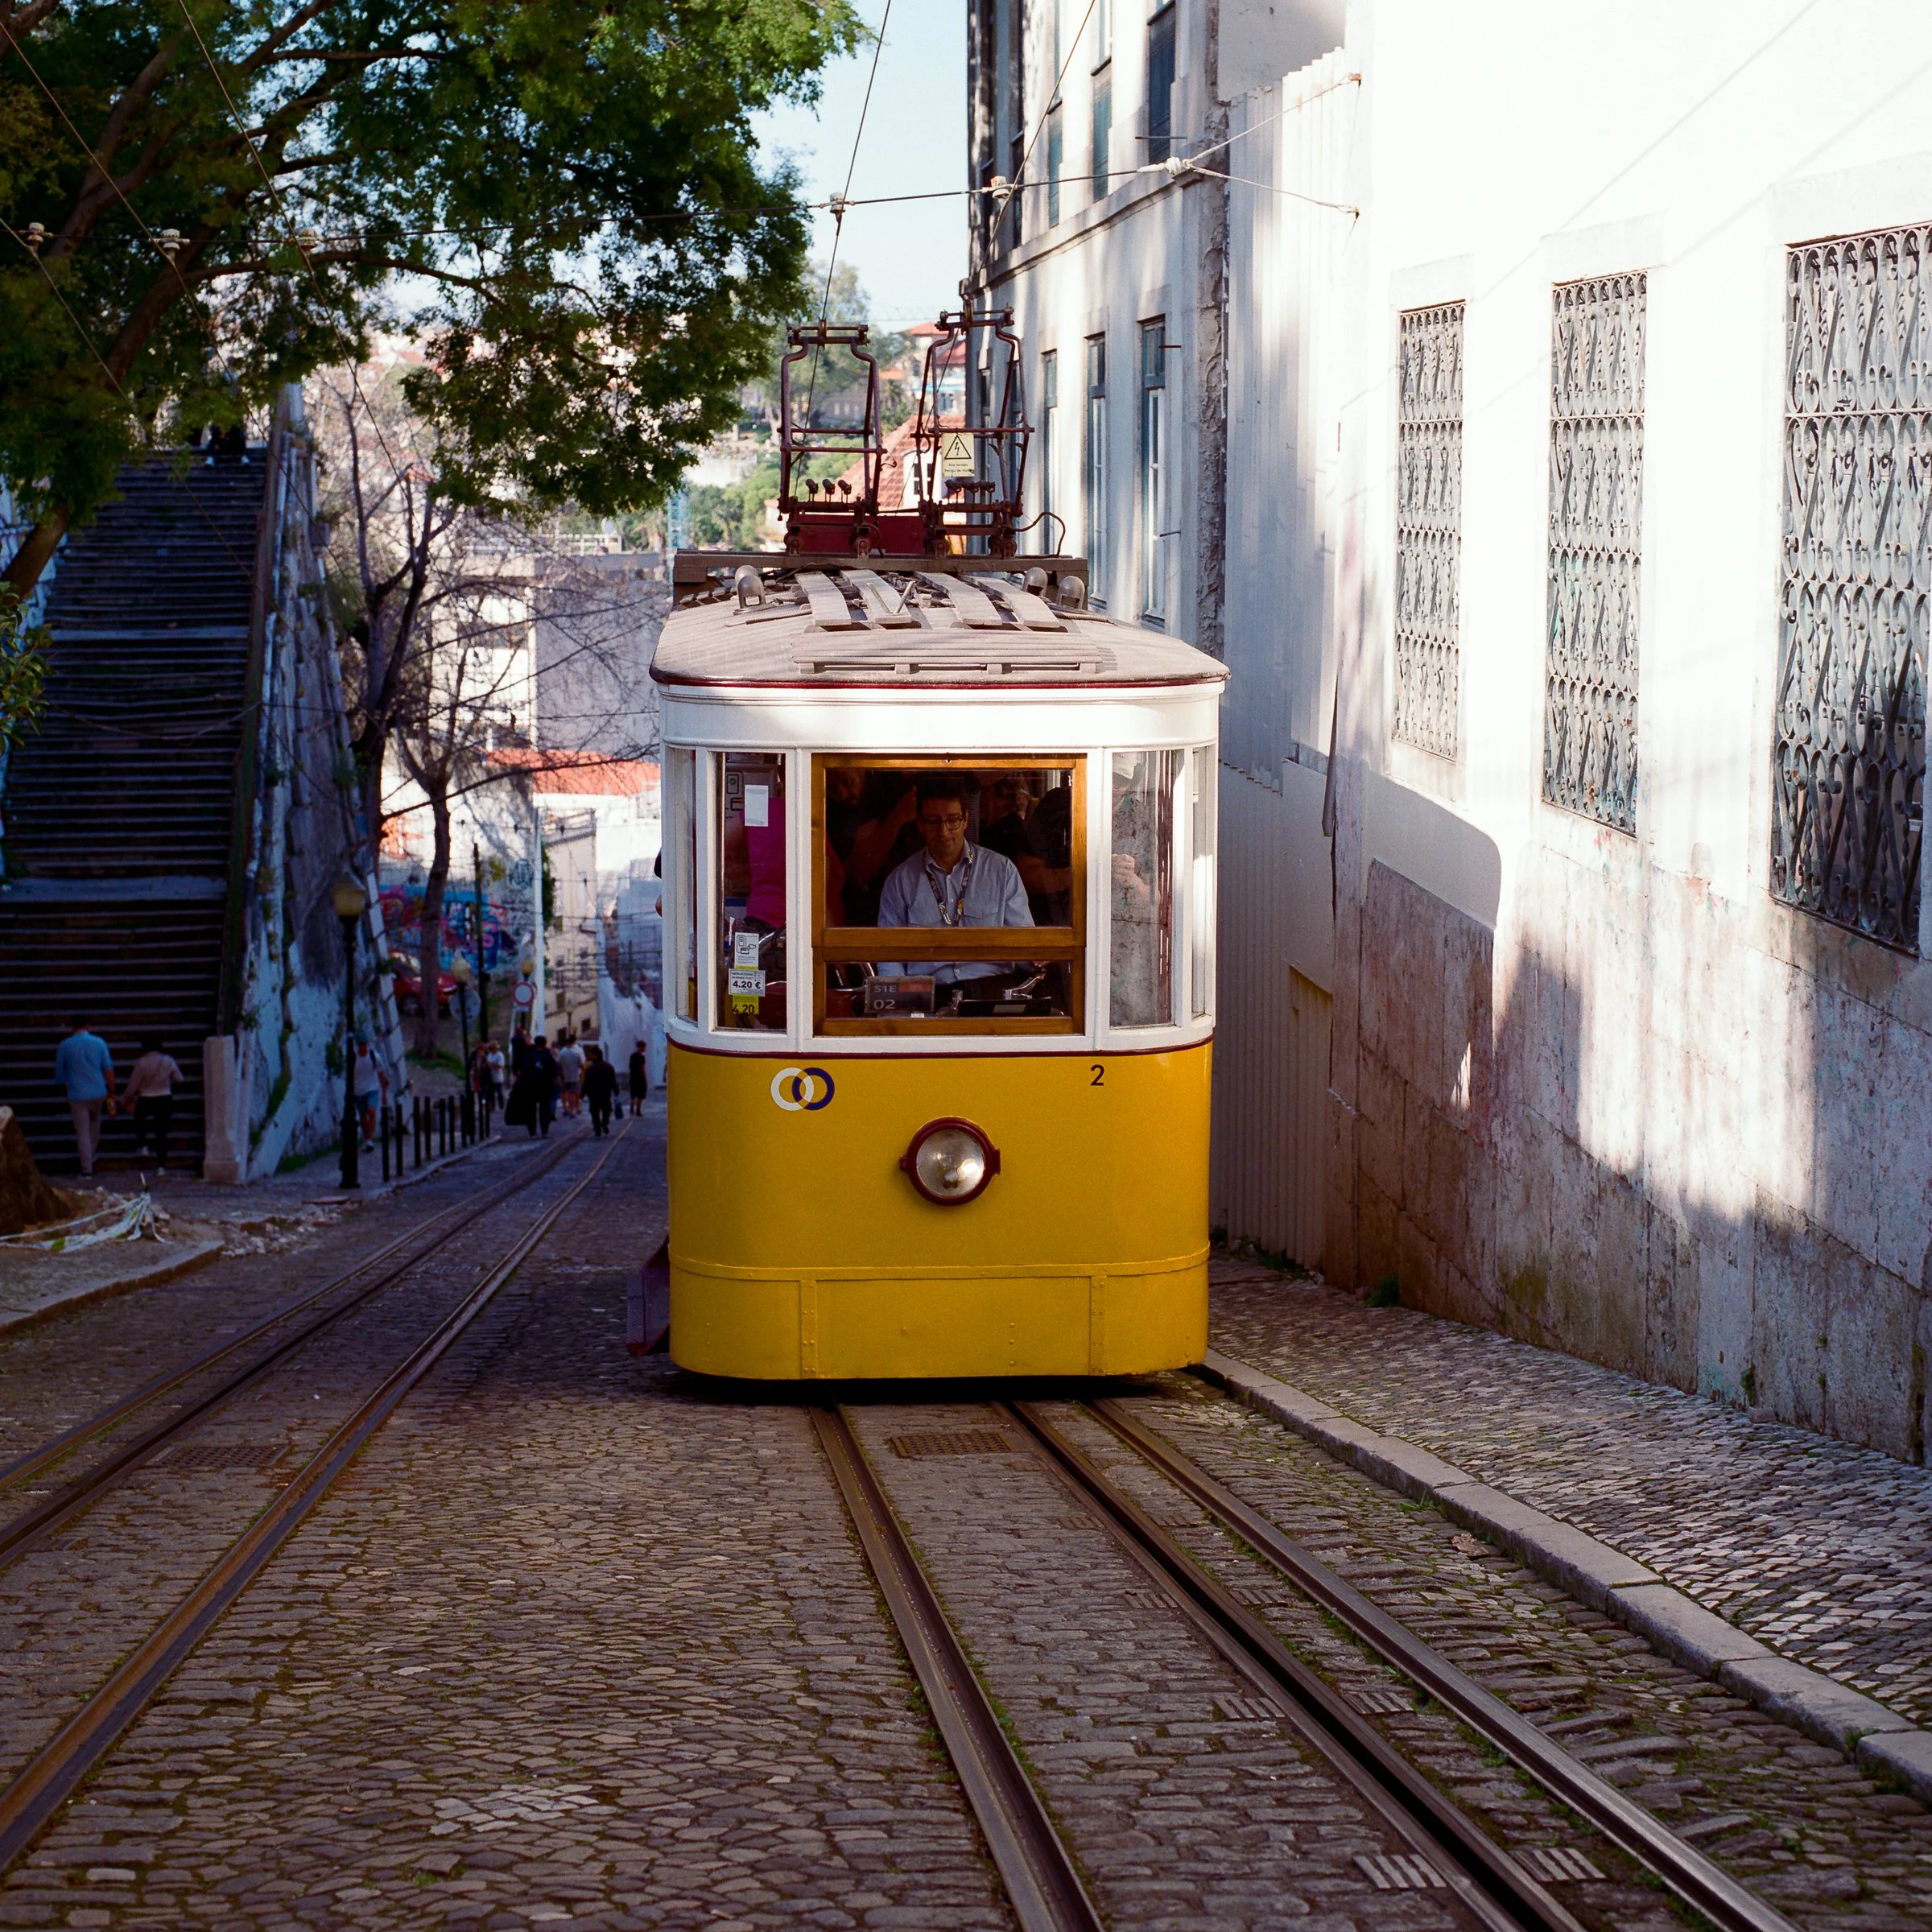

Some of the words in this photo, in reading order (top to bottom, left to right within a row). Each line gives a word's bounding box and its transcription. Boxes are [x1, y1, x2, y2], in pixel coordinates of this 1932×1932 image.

[733, 980, 752, 989] 4.20
[755, 981, 761, 989] €
[873, 999, 895, 1009] 02
[1090, 1064, 1104, 1086] 2
